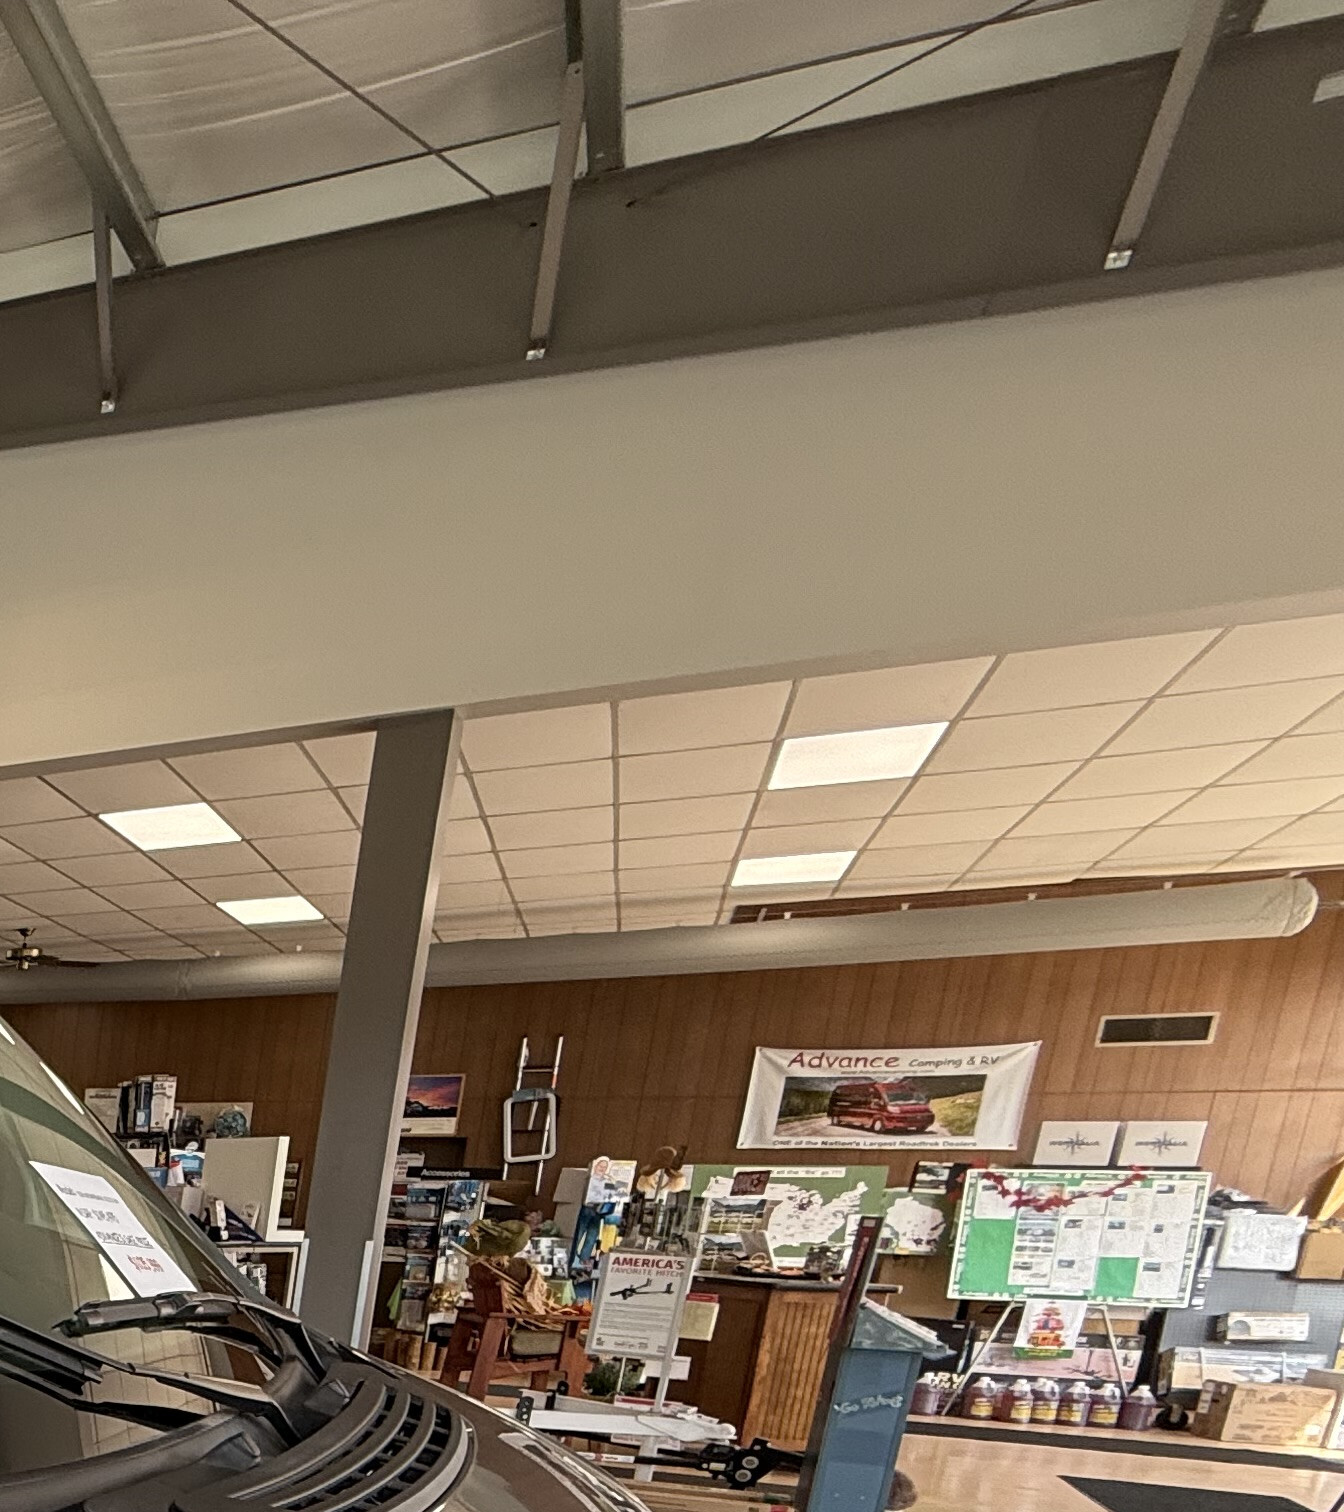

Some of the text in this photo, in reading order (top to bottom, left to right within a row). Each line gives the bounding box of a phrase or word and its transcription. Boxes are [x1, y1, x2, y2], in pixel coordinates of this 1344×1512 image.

[787, 1052, 1000, 1069] Advance Camping & RV
[421, 1168, 470, 1177] Accessories
[612, 1256, 685, 1270] AMERICA'S
[610, 1267, 684, 1278] FAVORITE HITCH
